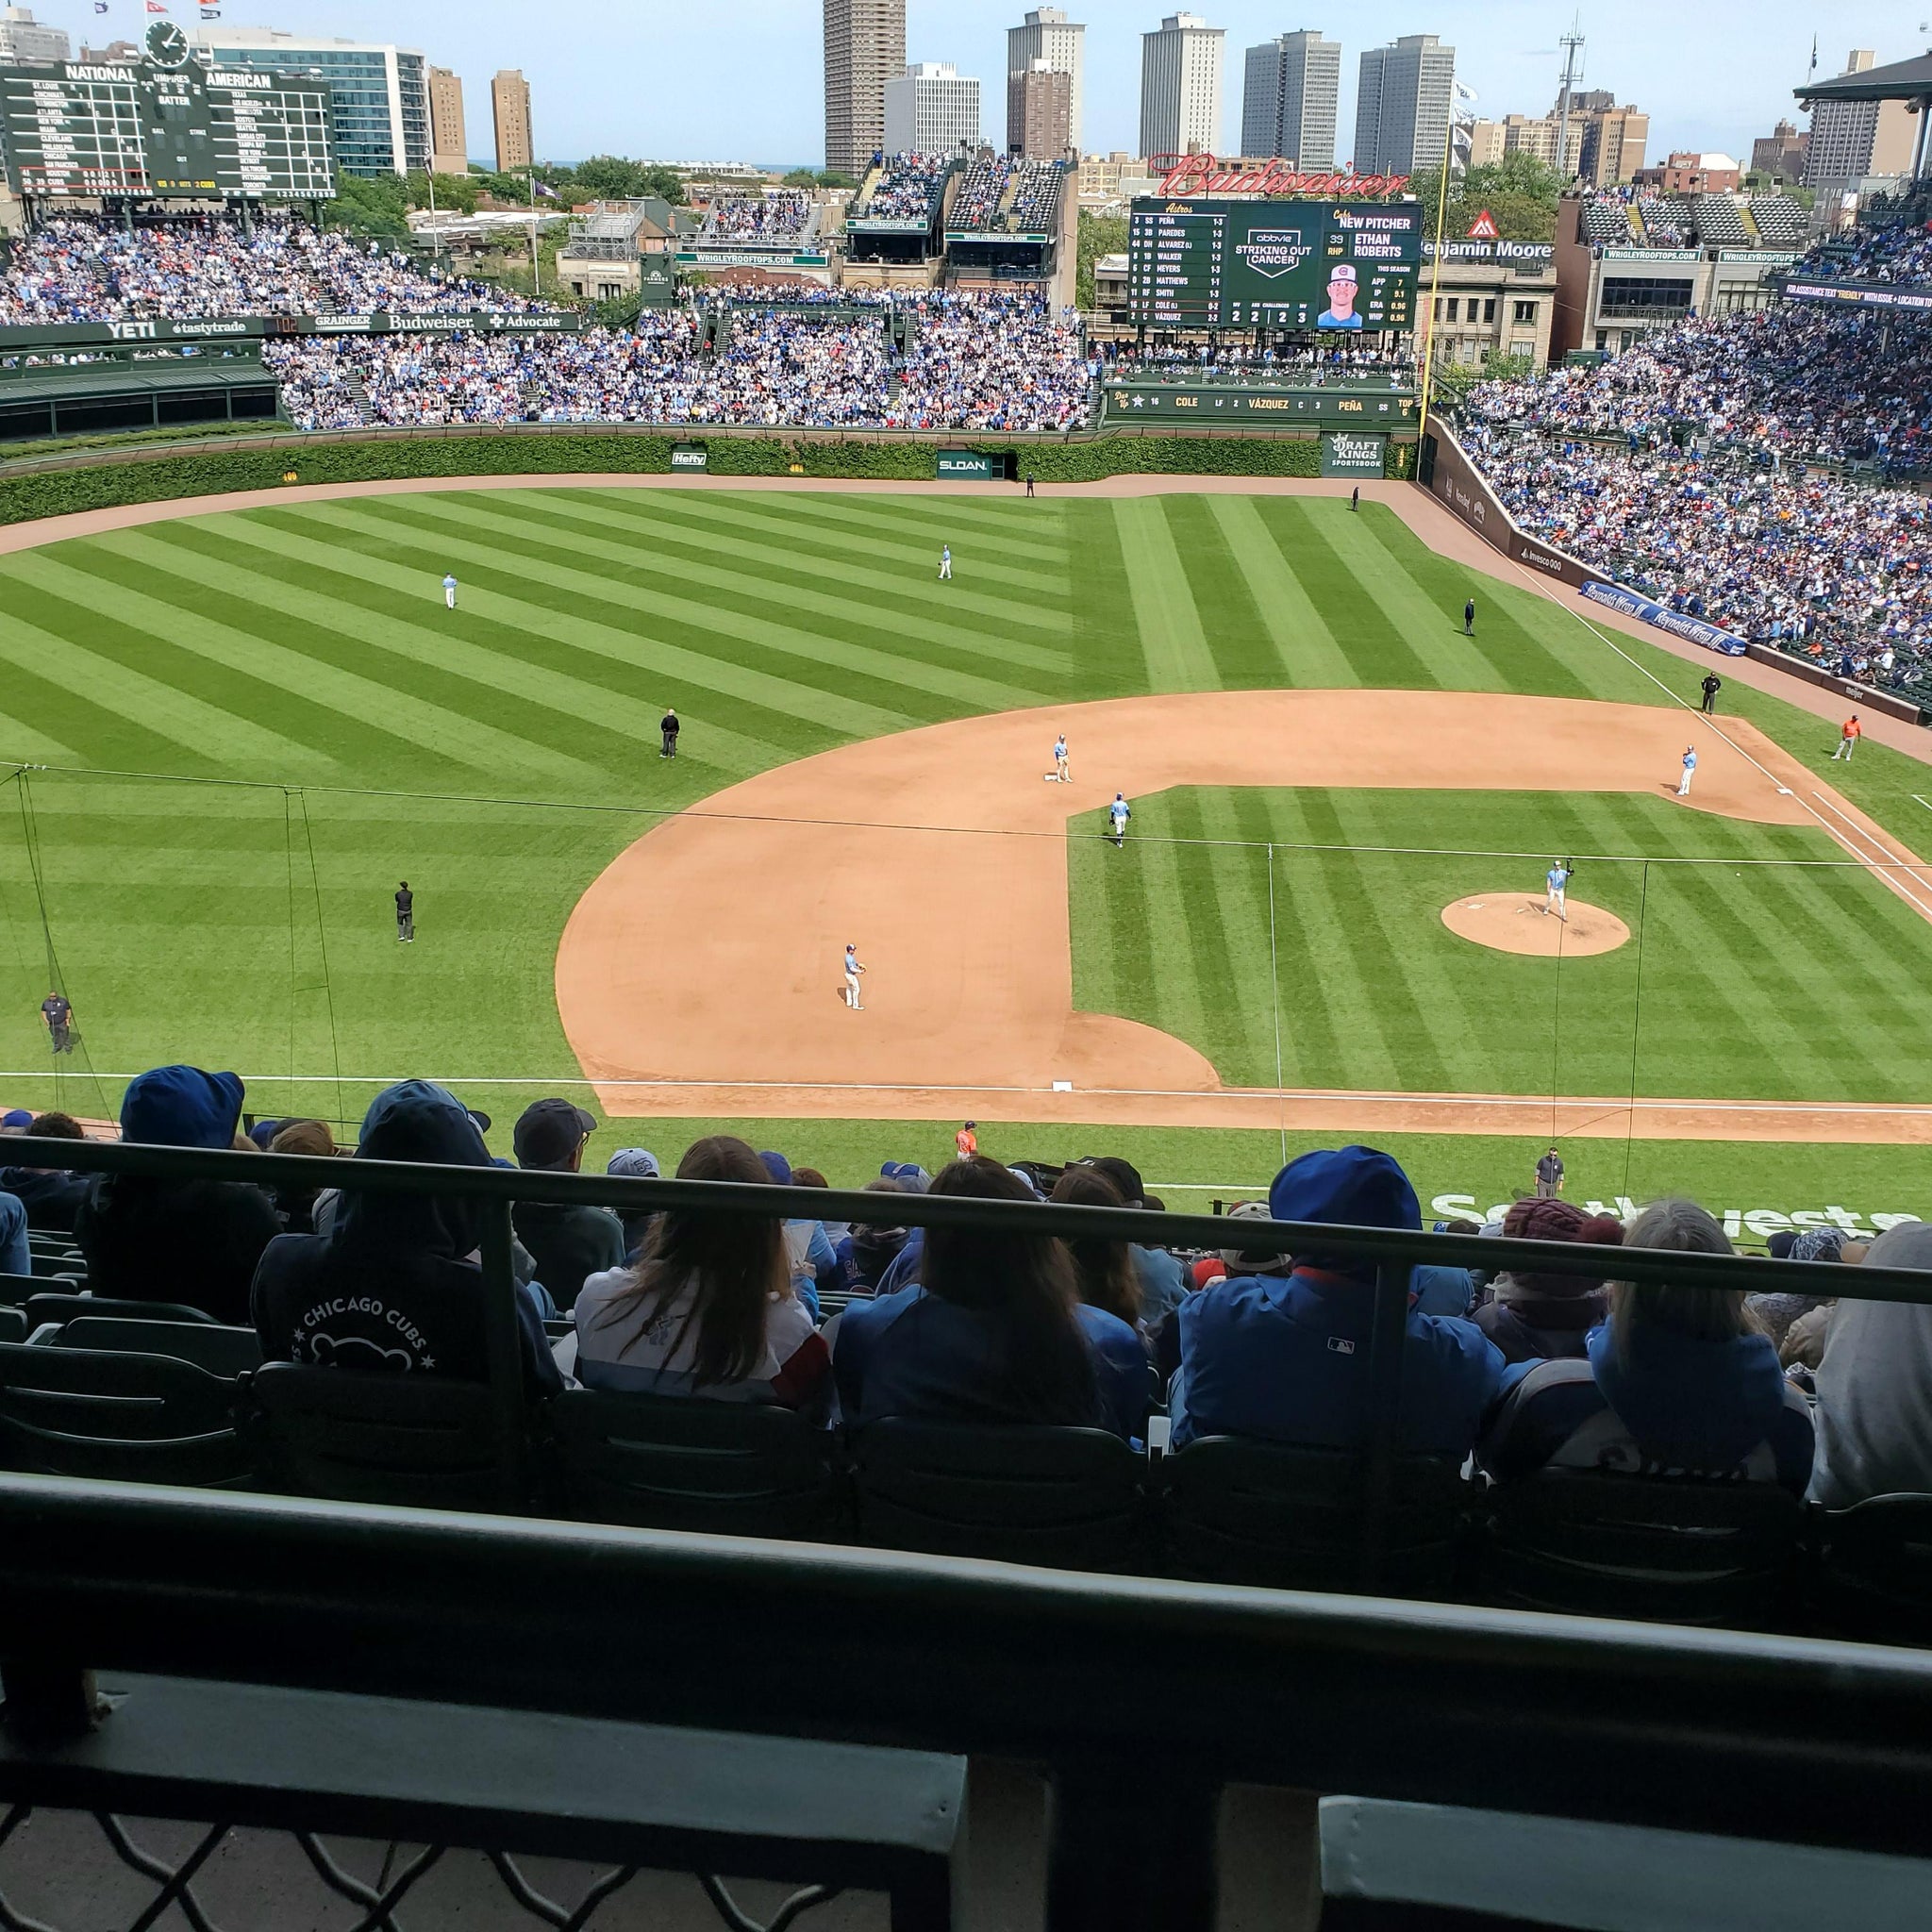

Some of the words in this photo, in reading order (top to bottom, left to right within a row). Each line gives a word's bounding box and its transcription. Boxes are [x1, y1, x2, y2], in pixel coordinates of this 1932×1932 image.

[65, 65, 137, 82] NATIONAL
[153, 74, 190, 83] UMPIRES
[206, 73, 272, 89] AMERICAN
[158, 95, 191, 106] BATTER
[1149, 153, 1409, 196] Budweiser
[1165, 202, 1193, 213] Astros
[1158, 216, 1174, 225] PEÑA
[1340, 217, 1363, 228] NEW
[1365, 218, 1410, 230] PITCHER
[1256, 234, 1292, 242] abbvie
[1355, 233, 1390, 245] ETHAN
[1236, 245, 1288, 255] STRIKING
[1290, 246, 1312, 256] OUT
[1327, 247, 1343, 256] RHP
[1354, 245, 1402, 258] ROBERTS
[1421, 240, 1491, 258] enjamin
[1496, 242, 1552, 258] Moore
[696, 254, 794, 264] WRIGLEYROOFTOPS.COM
[1251, 256, 1295, 264] CANCER
[1607, 250, 1696, 260] WRIGLEYROOFTOPS.COM
[1371, 277, 1386, 286] APP
[1156, 289, 1174, 297] SMITH
[1209, 290, 1219, 298] 1-3
[1208, 302, 1218, 310] 0-2
[1897, 295, 1924, 307] LOCATION
[315, 316, 371, 325] GRAINGER
[507, 318, 560, 327] Advocate
[1155, 312, 1181, 321] VÁZQUEZ
[1232, 310, 1240, 322] 2
[1251, 311, 1258, 322] 2
[1278, 311, 1287, 323] 2
[1298, 312, 1306, 323] 3
[1368, 312, 1384, 321] WHIP
[107, 322, 156, 338] YETI
[180, 322, 246, 336] tastytrade
[1151, 397, 1158, 406] 16
[1175, 397, 1198, 407] COLE
[1248, 397, 1289, 409] VÁZQUEZ
[1315, 401, 1321, 409] 3
[1339, 400, 1362, 411] PEÑA
[1398, 399, 1413, 408] TOP
[1332, 441, 1379, 452] DRAFT
[675, 454, 705, 465] Hefty
[1338, 450, 1377, 459] KINGS
[1529, 550, 1549, 566] Invesco
[1586, 584, 1618, 607] Reynolds
[1614, 596, 1635, 615] Wrap
[1654, 611, 1692, 635] Reynolds
[1689, 625, 1712, 645] Wrap
[304, 1296, 383, 1327] CHICAGO
[386, 1309, 427, 1351] CUBS
